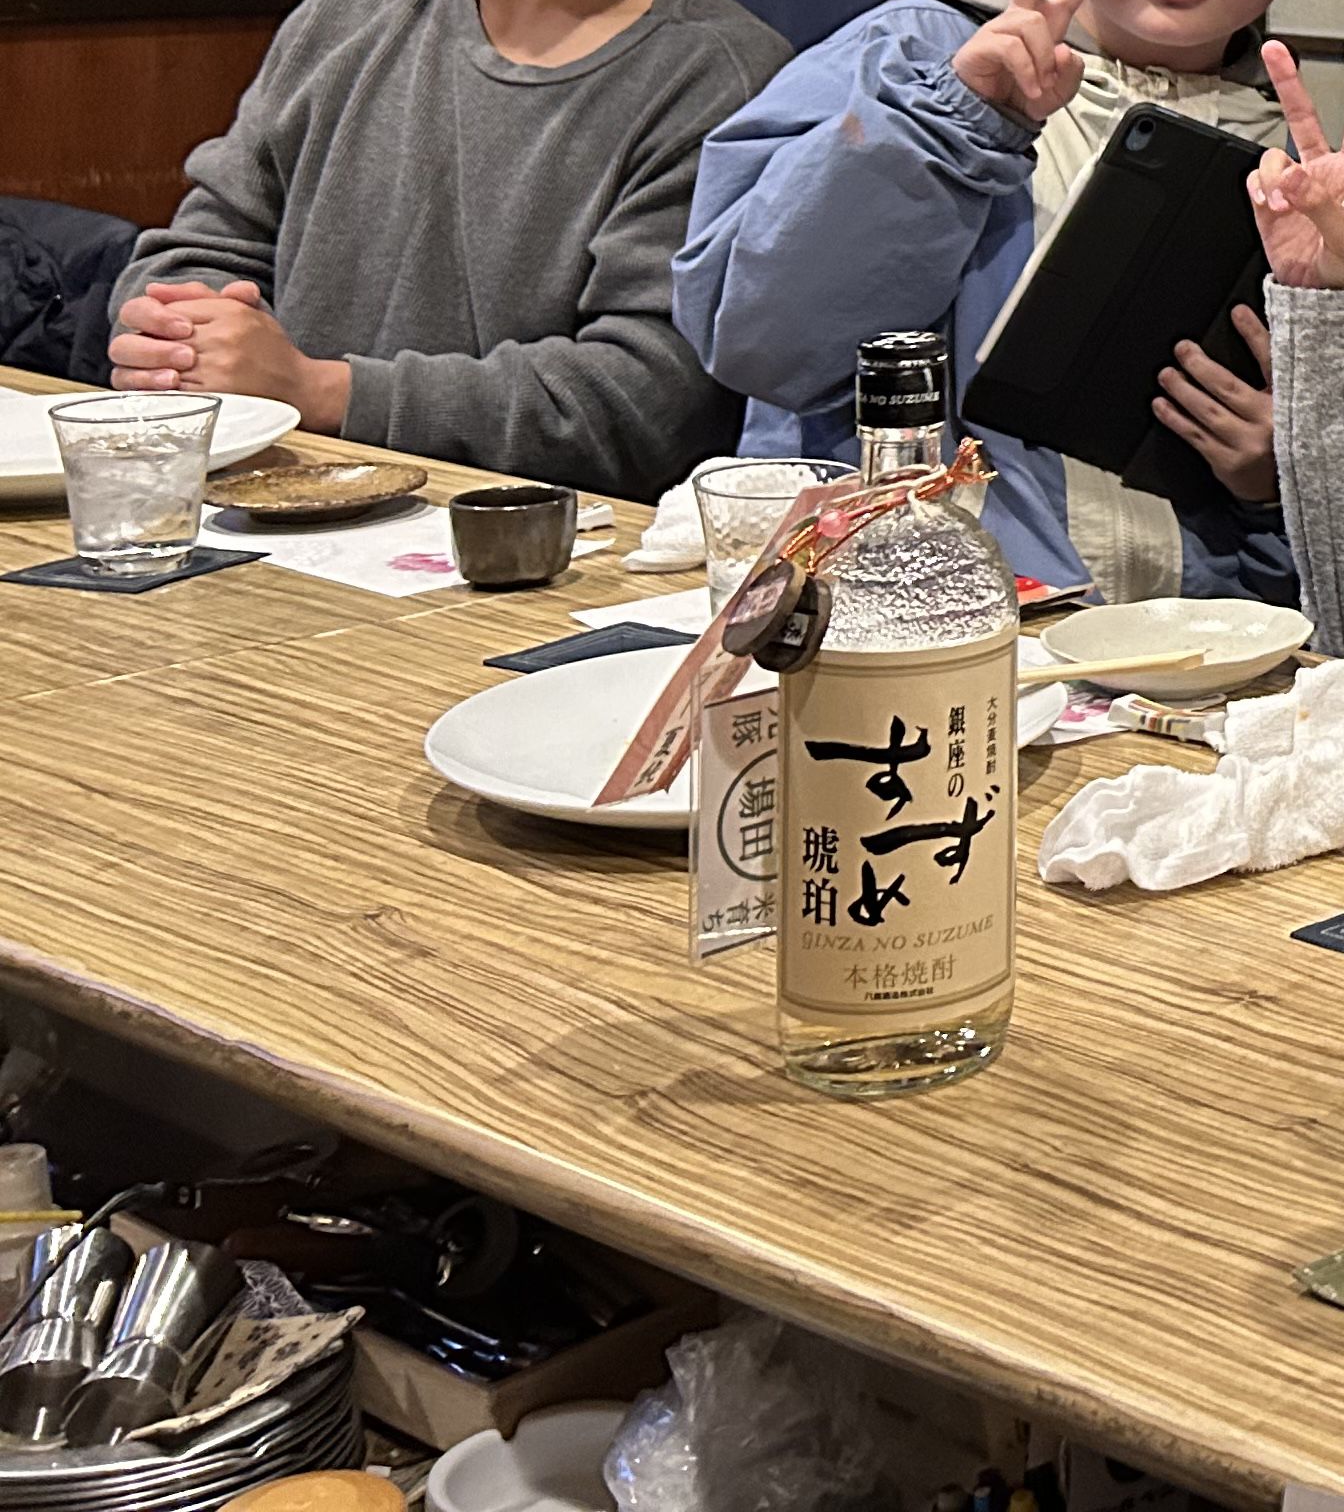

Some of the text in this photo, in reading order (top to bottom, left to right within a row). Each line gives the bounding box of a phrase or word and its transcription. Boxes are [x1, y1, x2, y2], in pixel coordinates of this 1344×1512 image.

[870, 395, 887, 405] NO
[889, 392, 939, 404] SUZUME
[947, 705, 966, 798] 銀座の
[804, 714, 1000, 926] すずめ
[802, 825, 839, 926] 琥珀
[801, 914, 994, 952] GINZA NO SUZUME
[844, 953, 957, 989] 本格焼酎
